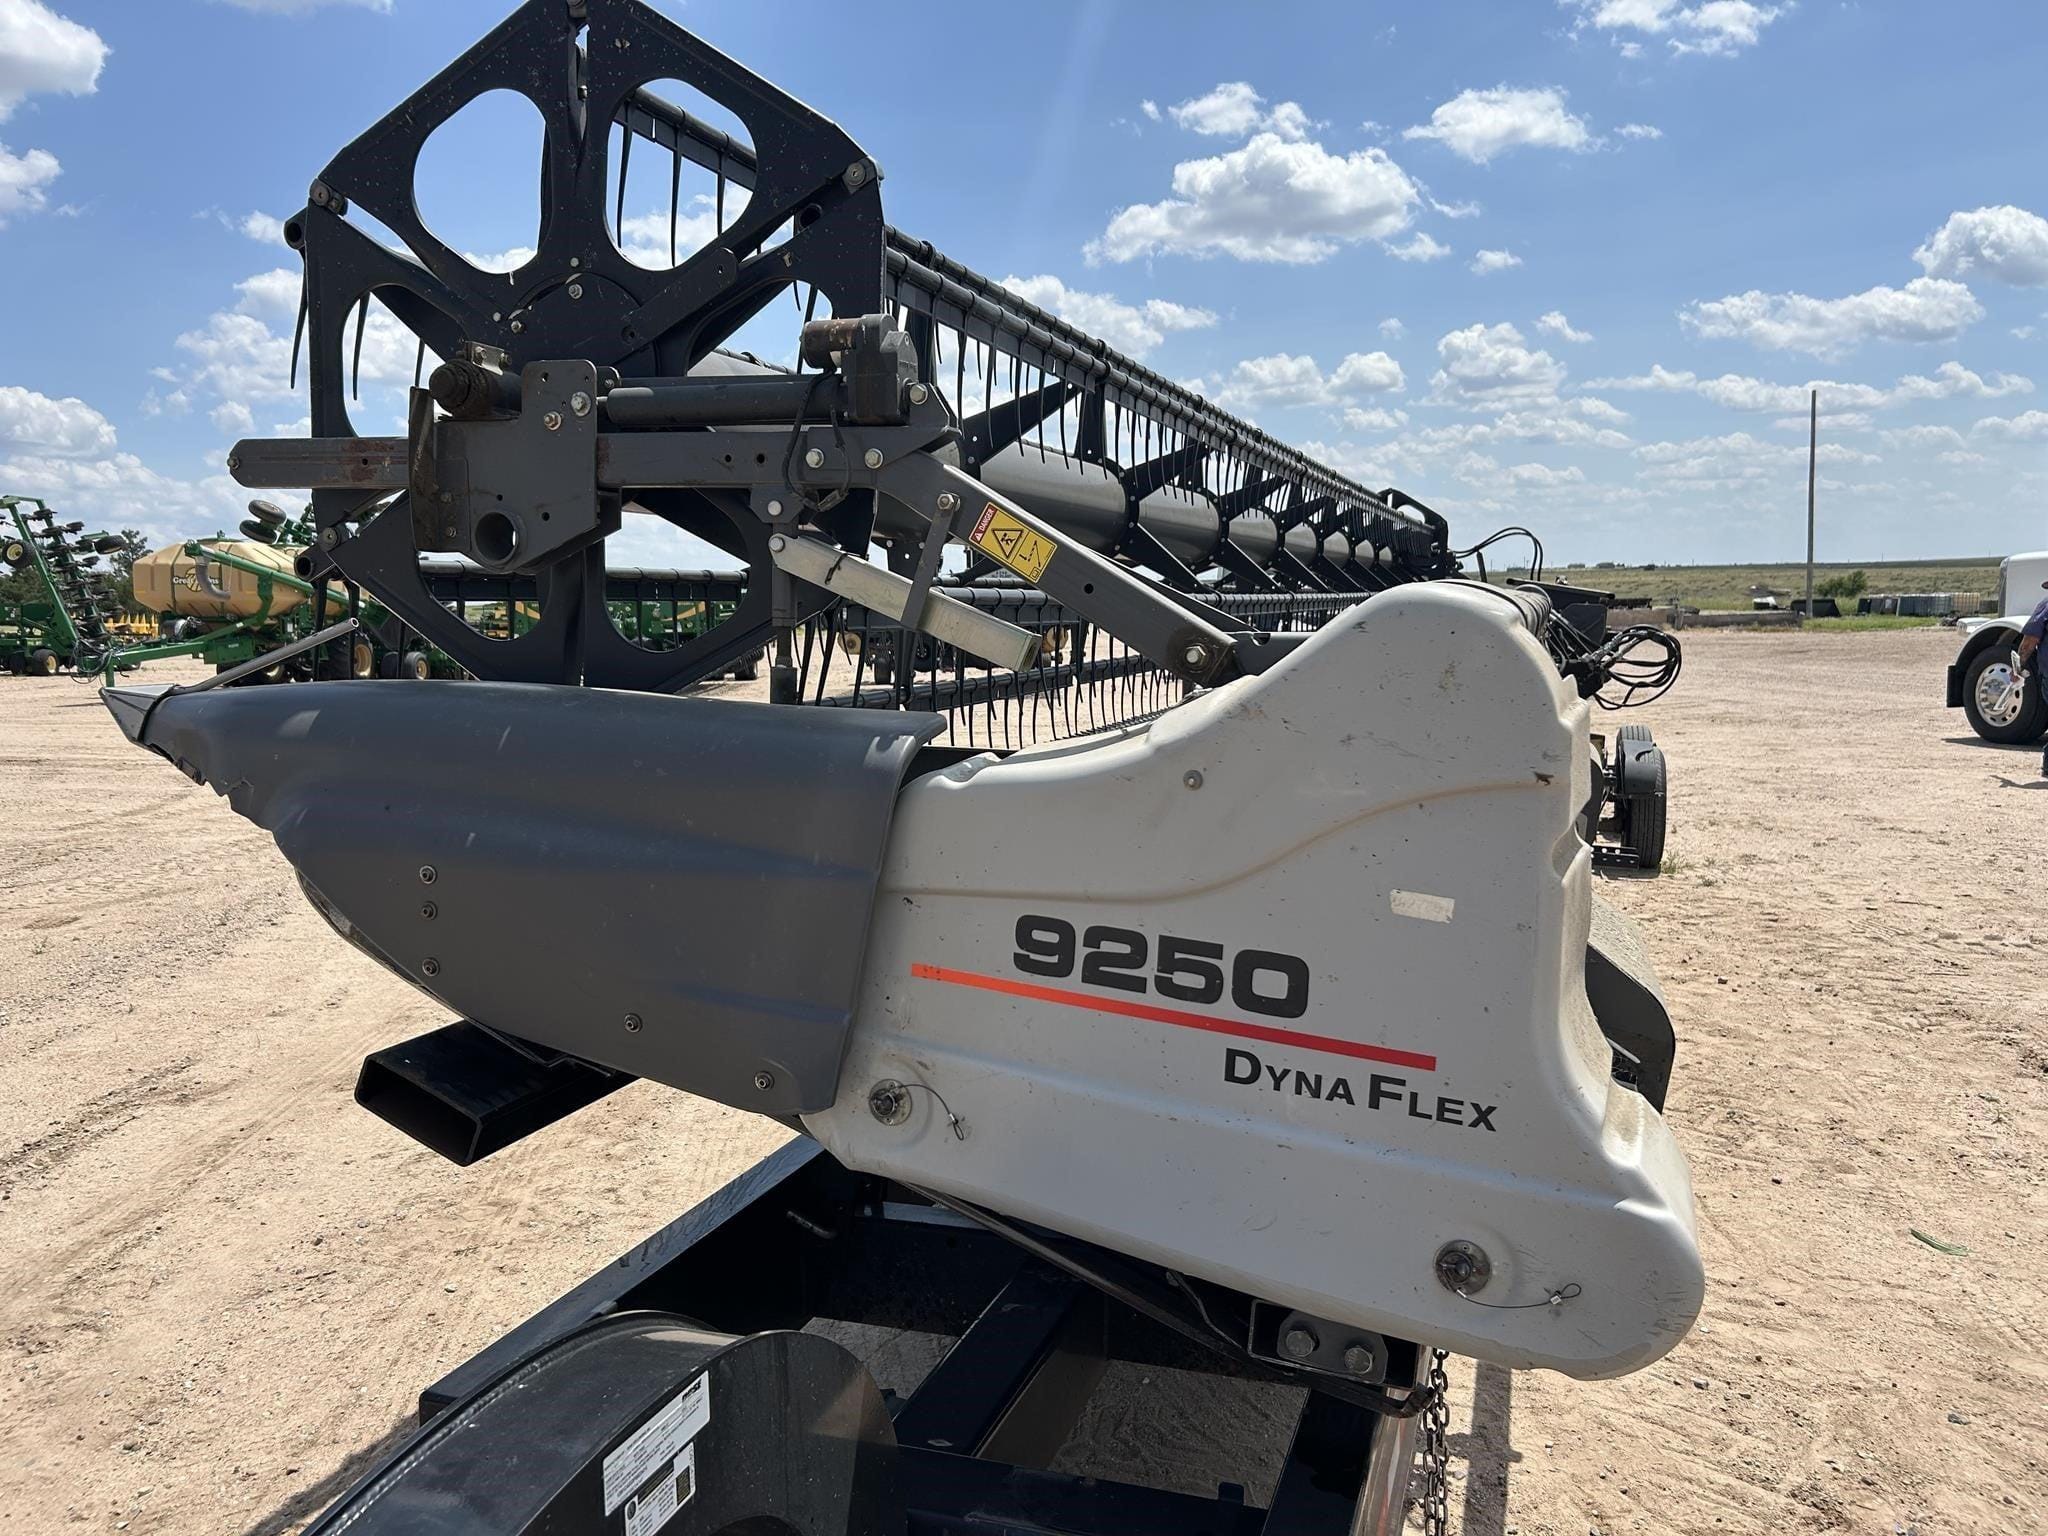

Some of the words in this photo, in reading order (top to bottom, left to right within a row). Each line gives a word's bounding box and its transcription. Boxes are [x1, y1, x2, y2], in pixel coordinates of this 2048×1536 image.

[978, 508, 995, 532] DANGER
[1013, 914, 1309, 1019] 9250
[1224, 1047, 1356, 1106] DYNA
[1367, 1073, 1498, 1132] FLEX
